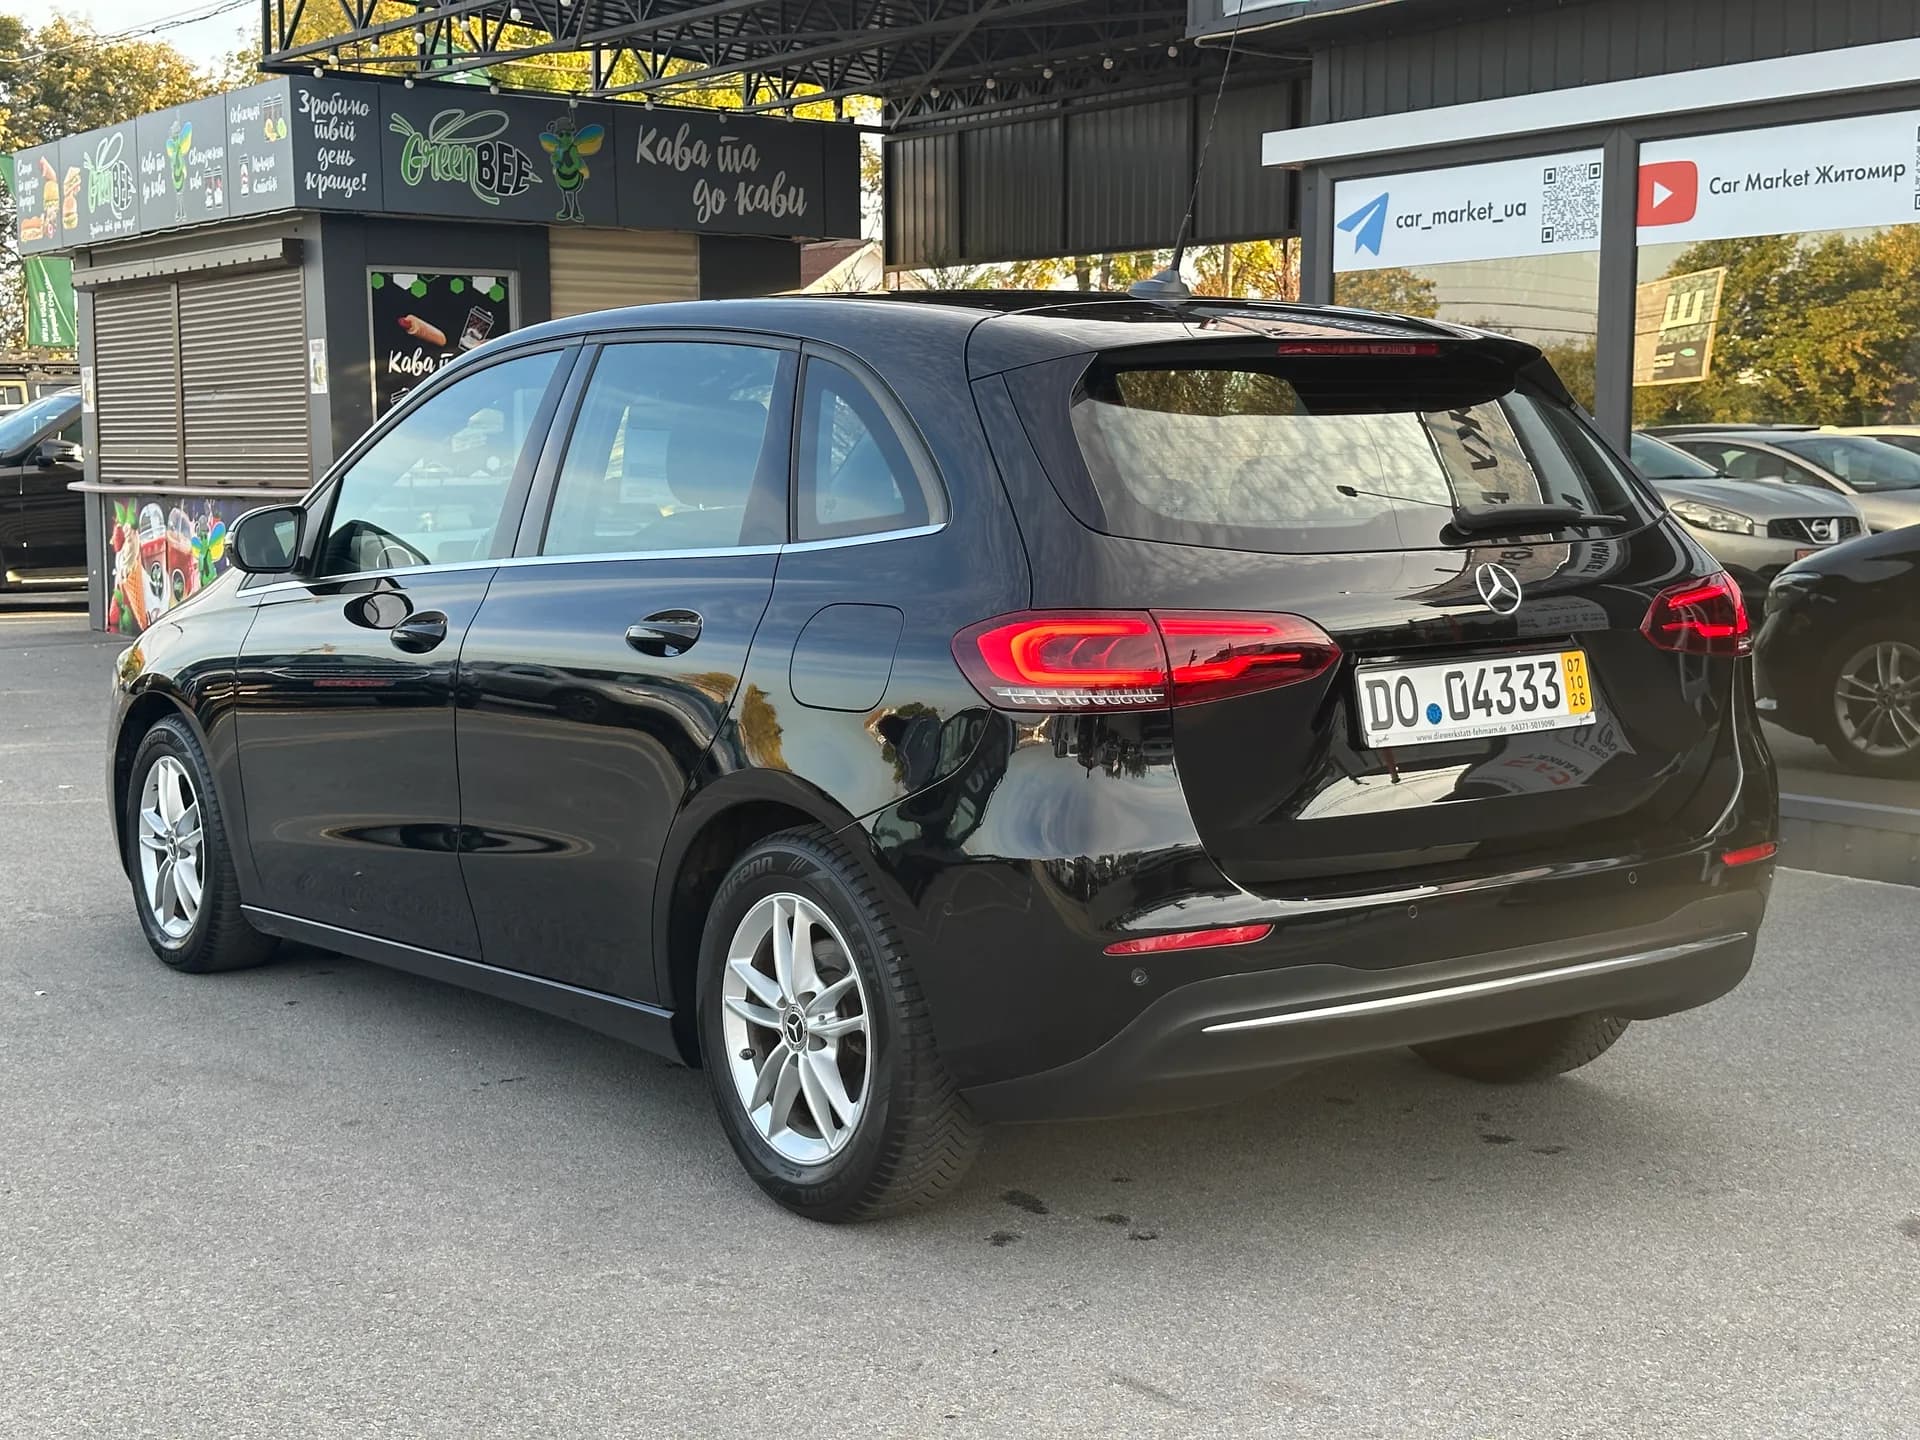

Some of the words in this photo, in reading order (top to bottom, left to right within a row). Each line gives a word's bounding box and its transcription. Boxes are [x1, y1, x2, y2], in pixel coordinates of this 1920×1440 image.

[298, 89, 371, 122] Зробимо
[314, 116, 356, 141] твій
[317, 147, 356, 171] день
[636, 122, 711, 171] Кава
[717, 136, 760, 173] та
[305, 171, 368, 199] краще!
[1709, 177, 1740, 194] Car
[1744, 168, 1810, 192] Market
[1814, 163, 1906, 185] Житомир
[692, 178, 728, 224] до
[734, 170, 807, 218] кави
[1396, 200, 1527, 230] car_market_ua
[388, 347, 436, 376] Кава
[1567, 658, 1580, 673] 07
[1365, 675, 1419, 731] DO
[1445, 661, 1561, 721] 04333
[1570, 675, 1583, 690] 10
[1571, 692, 1586, 706] 26
